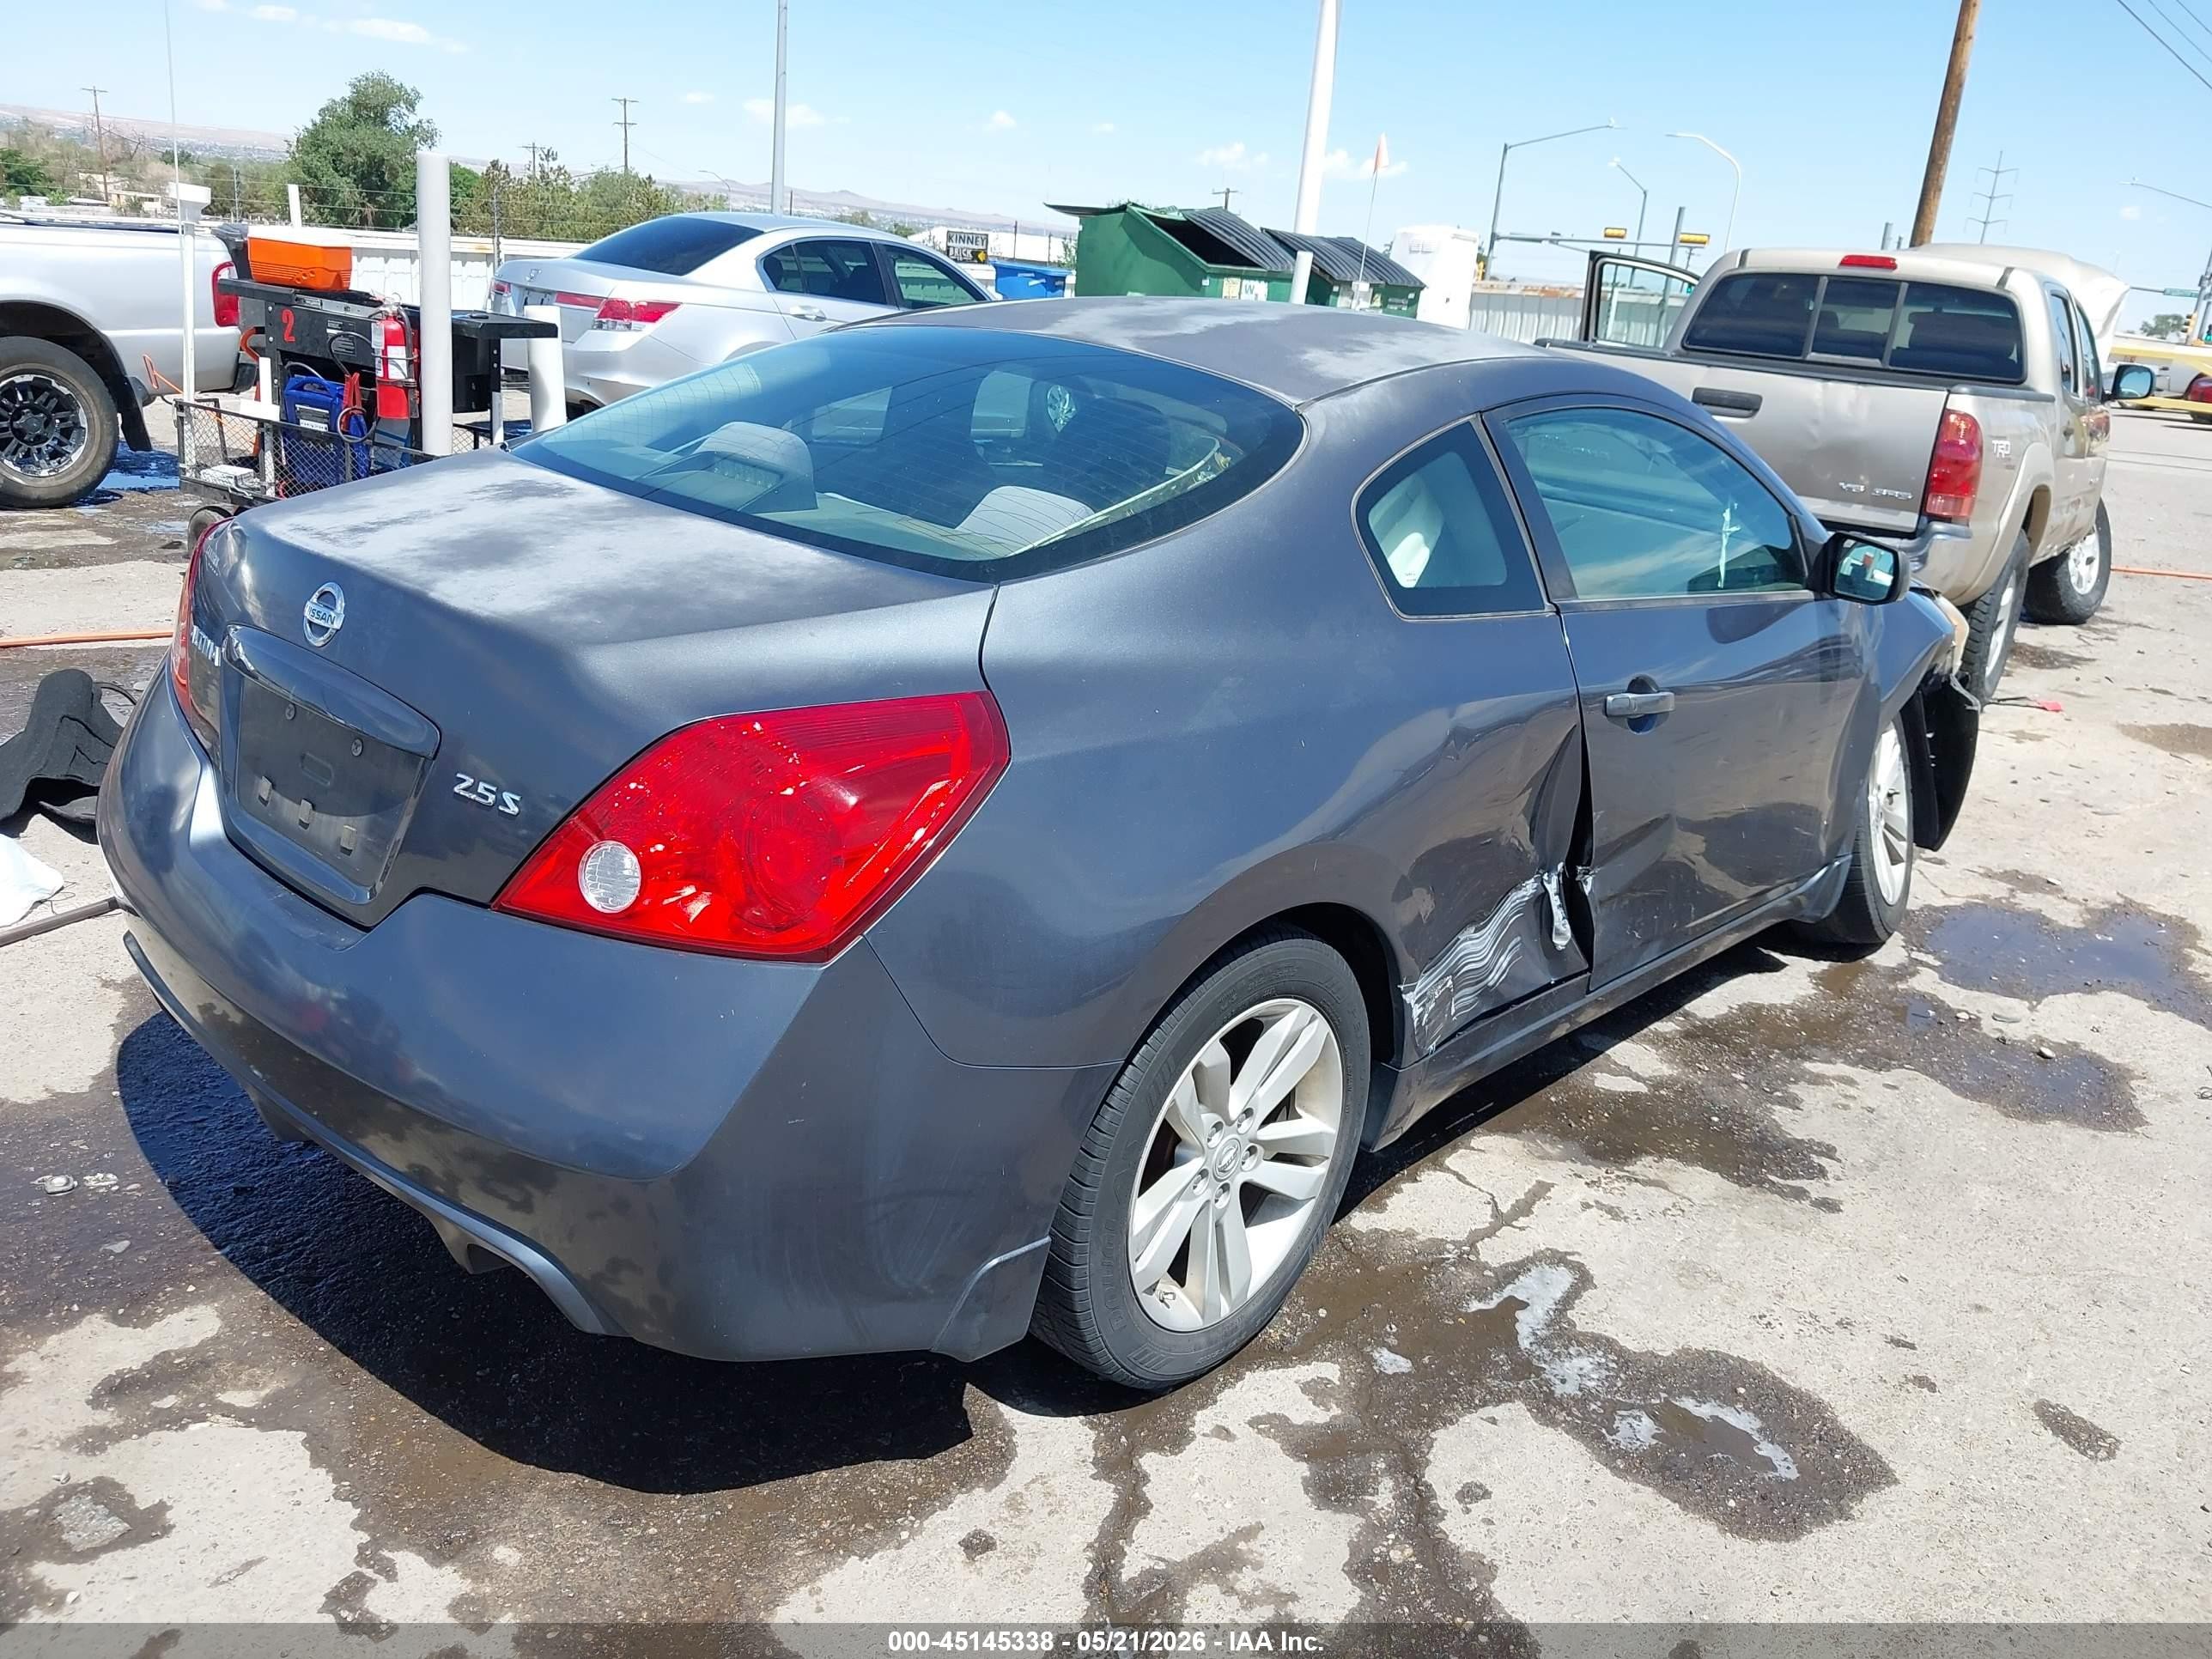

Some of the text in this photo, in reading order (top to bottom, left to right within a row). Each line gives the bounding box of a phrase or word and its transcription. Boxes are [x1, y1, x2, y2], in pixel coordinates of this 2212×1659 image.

[948, 233, 987, 246] KINNEY
[949, 247, 973, 258] BRICK
[282, 307, 296, 343] 2
